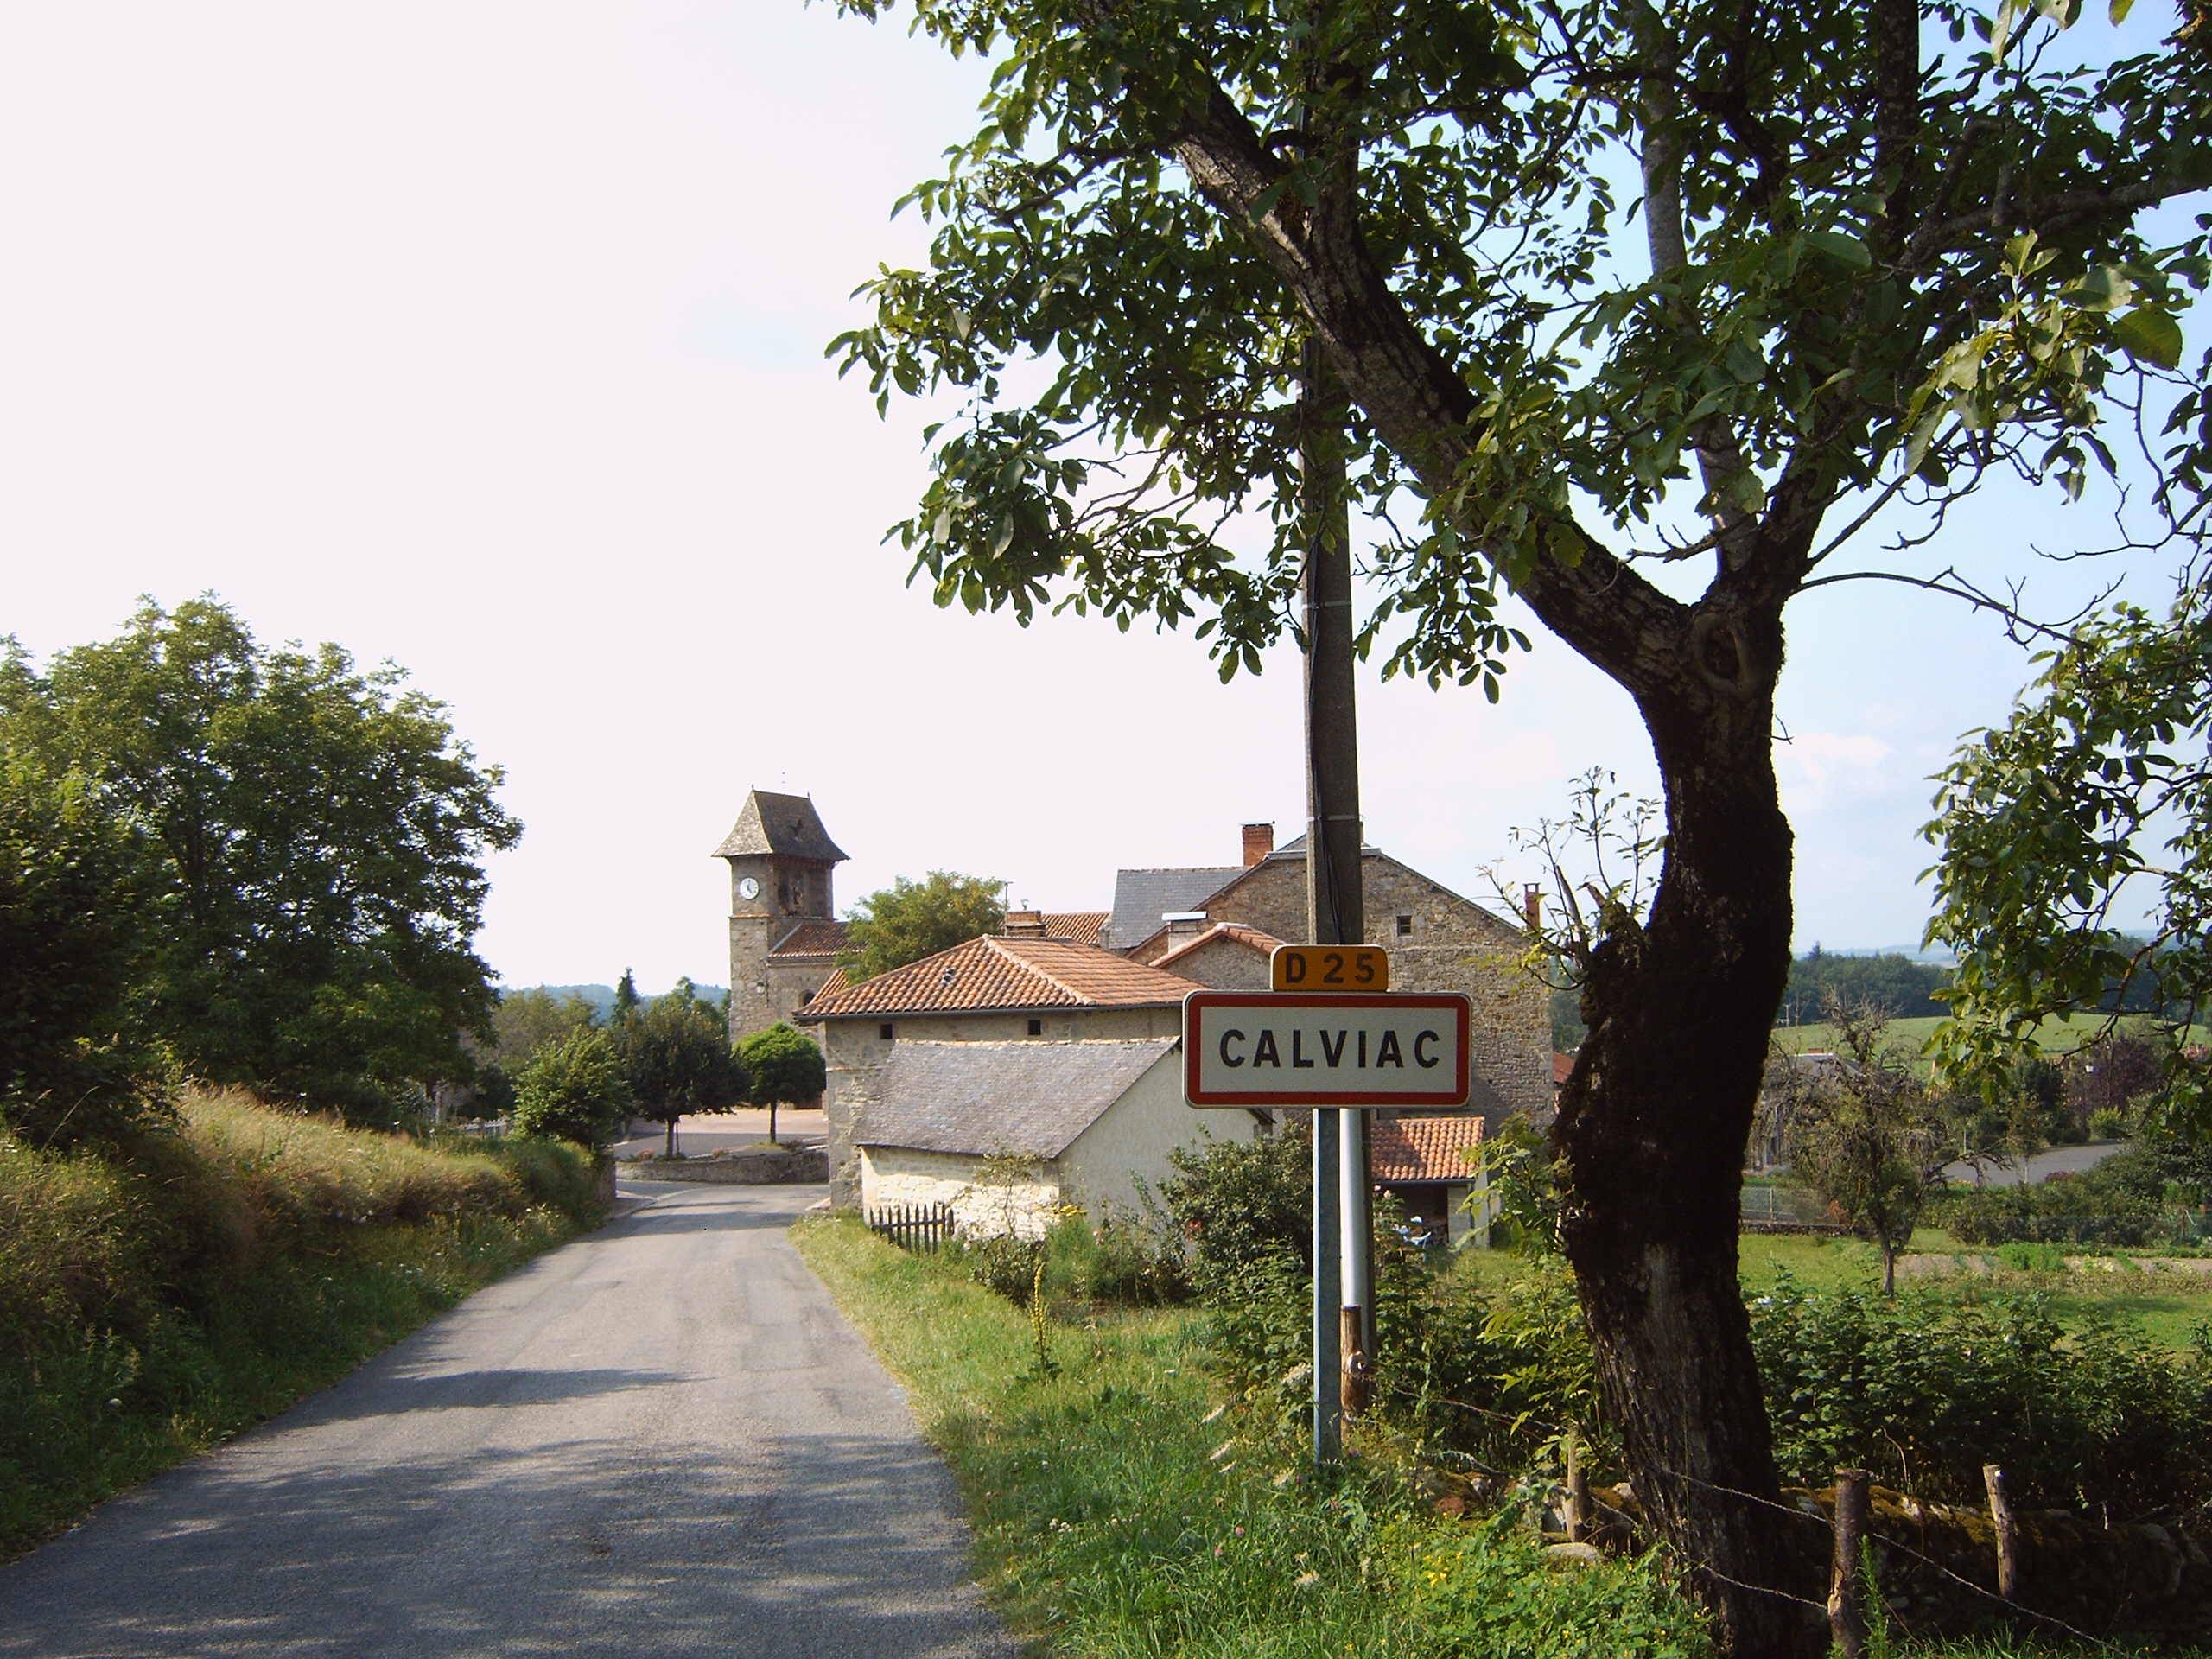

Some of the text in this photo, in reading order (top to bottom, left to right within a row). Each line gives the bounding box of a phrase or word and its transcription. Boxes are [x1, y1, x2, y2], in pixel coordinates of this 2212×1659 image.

[1285, 953, 1375, 984] D 25
[1219, 1029, 1440, 1069] CALVIAC
